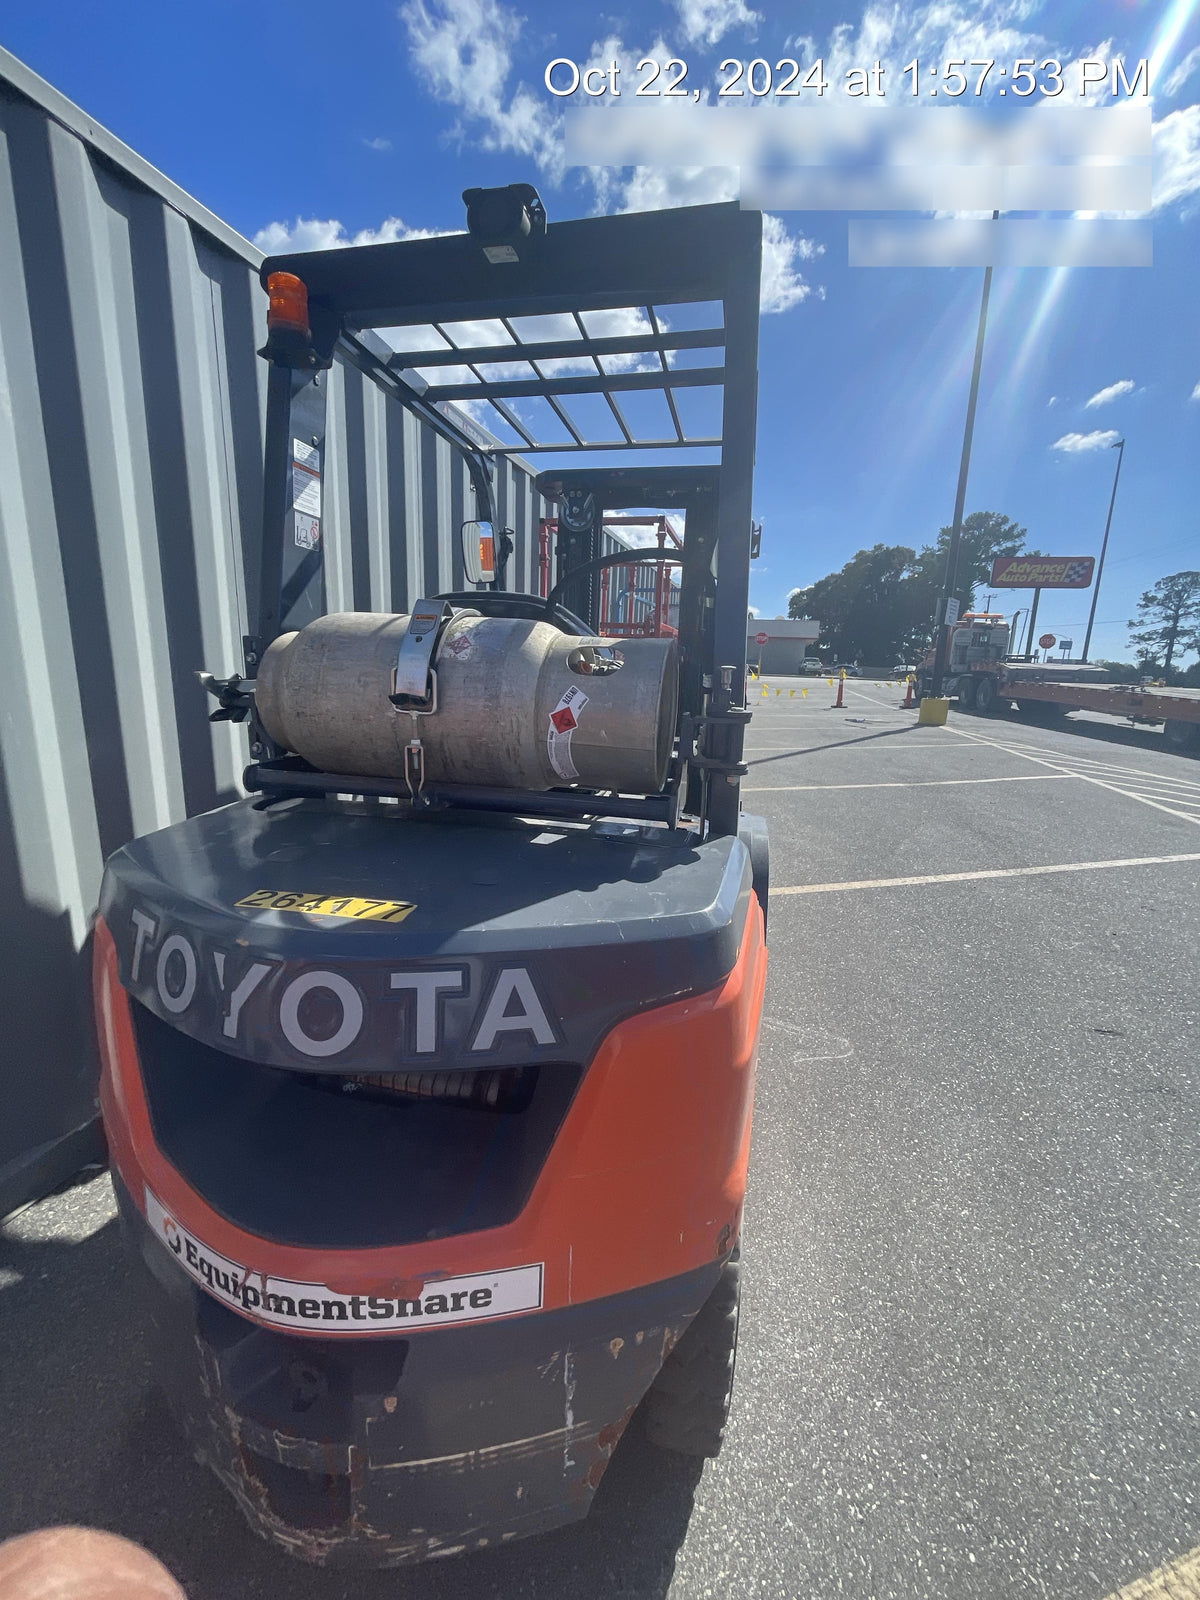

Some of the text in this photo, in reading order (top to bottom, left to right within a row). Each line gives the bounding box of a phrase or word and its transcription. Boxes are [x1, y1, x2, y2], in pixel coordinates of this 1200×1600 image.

[997, 572, 1061, 582] Auto Parts
[1006, 562, 1065, 573] Advance
[1040, 637, 1056, 645] STOP
[239, 890, 414, 920] 264177
[129, 908, 557, 1057] TOYOTA
[184, 1237, 494, 1321] EquipmentShare
